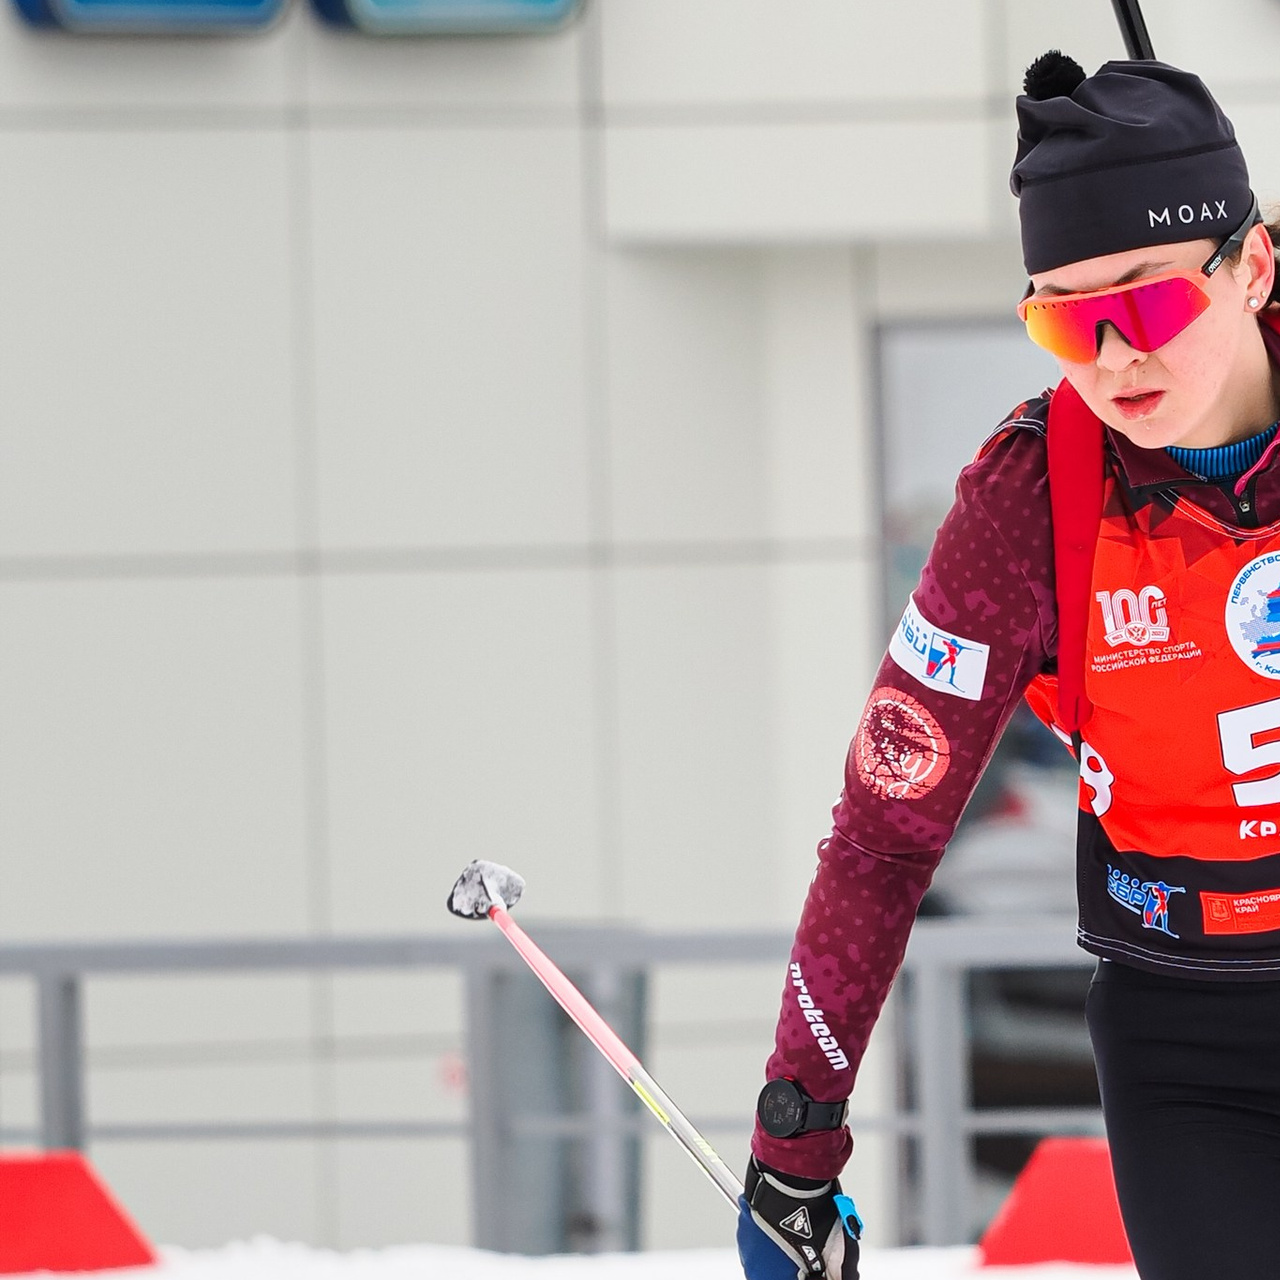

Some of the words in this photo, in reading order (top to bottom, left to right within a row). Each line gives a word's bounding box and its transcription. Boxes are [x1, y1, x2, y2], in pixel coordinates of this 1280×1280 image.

[1147, 199, 1228, 228] MOAX
[1095, 585, 1168, 635] 100
[1151, 597, 1168, 609] ЛЕТ
[1091, 656, 1147, 673] РОССИЙСКОЙ
[1148, 649, 1202, 664] ФЕДЕРАЦИИ
[1093, 648, 1161, 663] МИНИСТЕРСТВО
[1163, 641, 1197, 653] СПОРТА
[1235, 905, 1259, 914] КРАЙ
